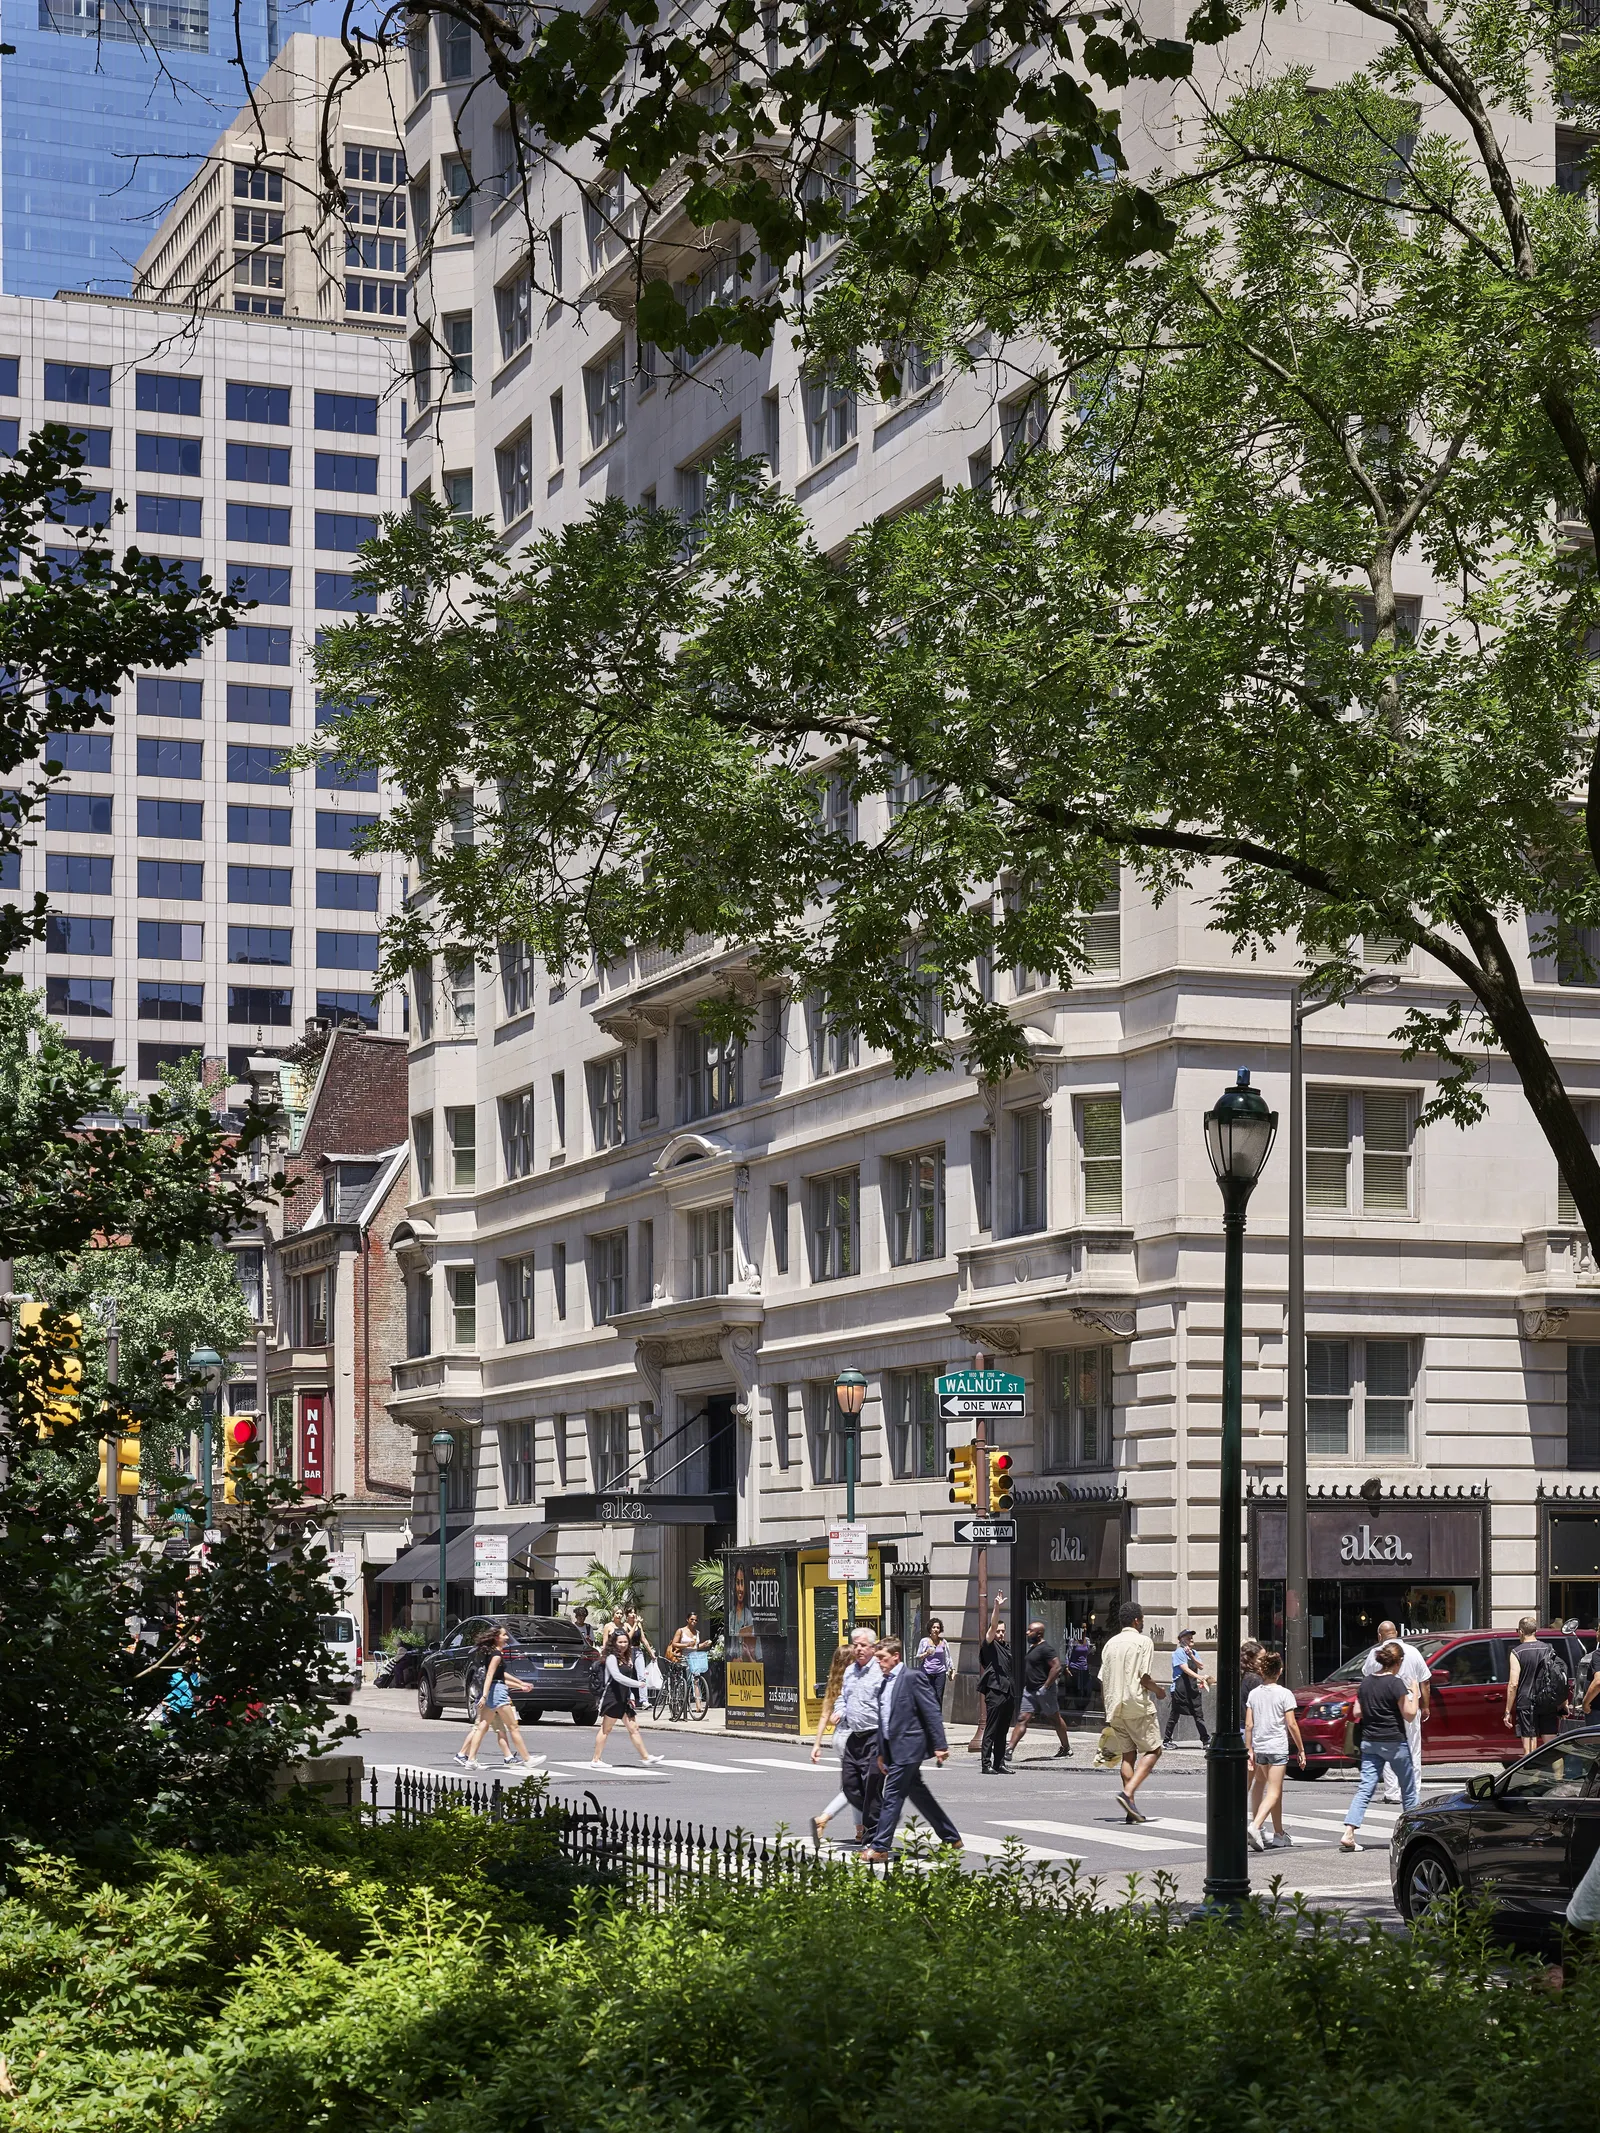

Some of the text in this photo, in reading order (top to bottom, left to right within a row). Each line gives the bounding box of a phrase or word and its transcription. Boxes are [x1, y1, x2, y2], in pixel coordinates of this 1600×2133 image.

[945, 1379, 1018, 1393] WALNUT ST
[963, 1401, 1013, 1411] ONE WAY
[306, 1409, 319, 1464] NAIL
[304, 1470, 321, 1479] BAR
[602, 1495, 653, 1520] aka.
[972, 1527, 1010, 1537] ONE WAY
[1050, 1527, 1086, 1562] aka.
[1340, 1524, 1413, 1561] aka.
[752, 1567, 760, 1576] You
[750, 1580, 780, 1608] BETTER
[729, 1669, 762, 1686] MARTIN
[740, 1690, 751, 1701] LAW
